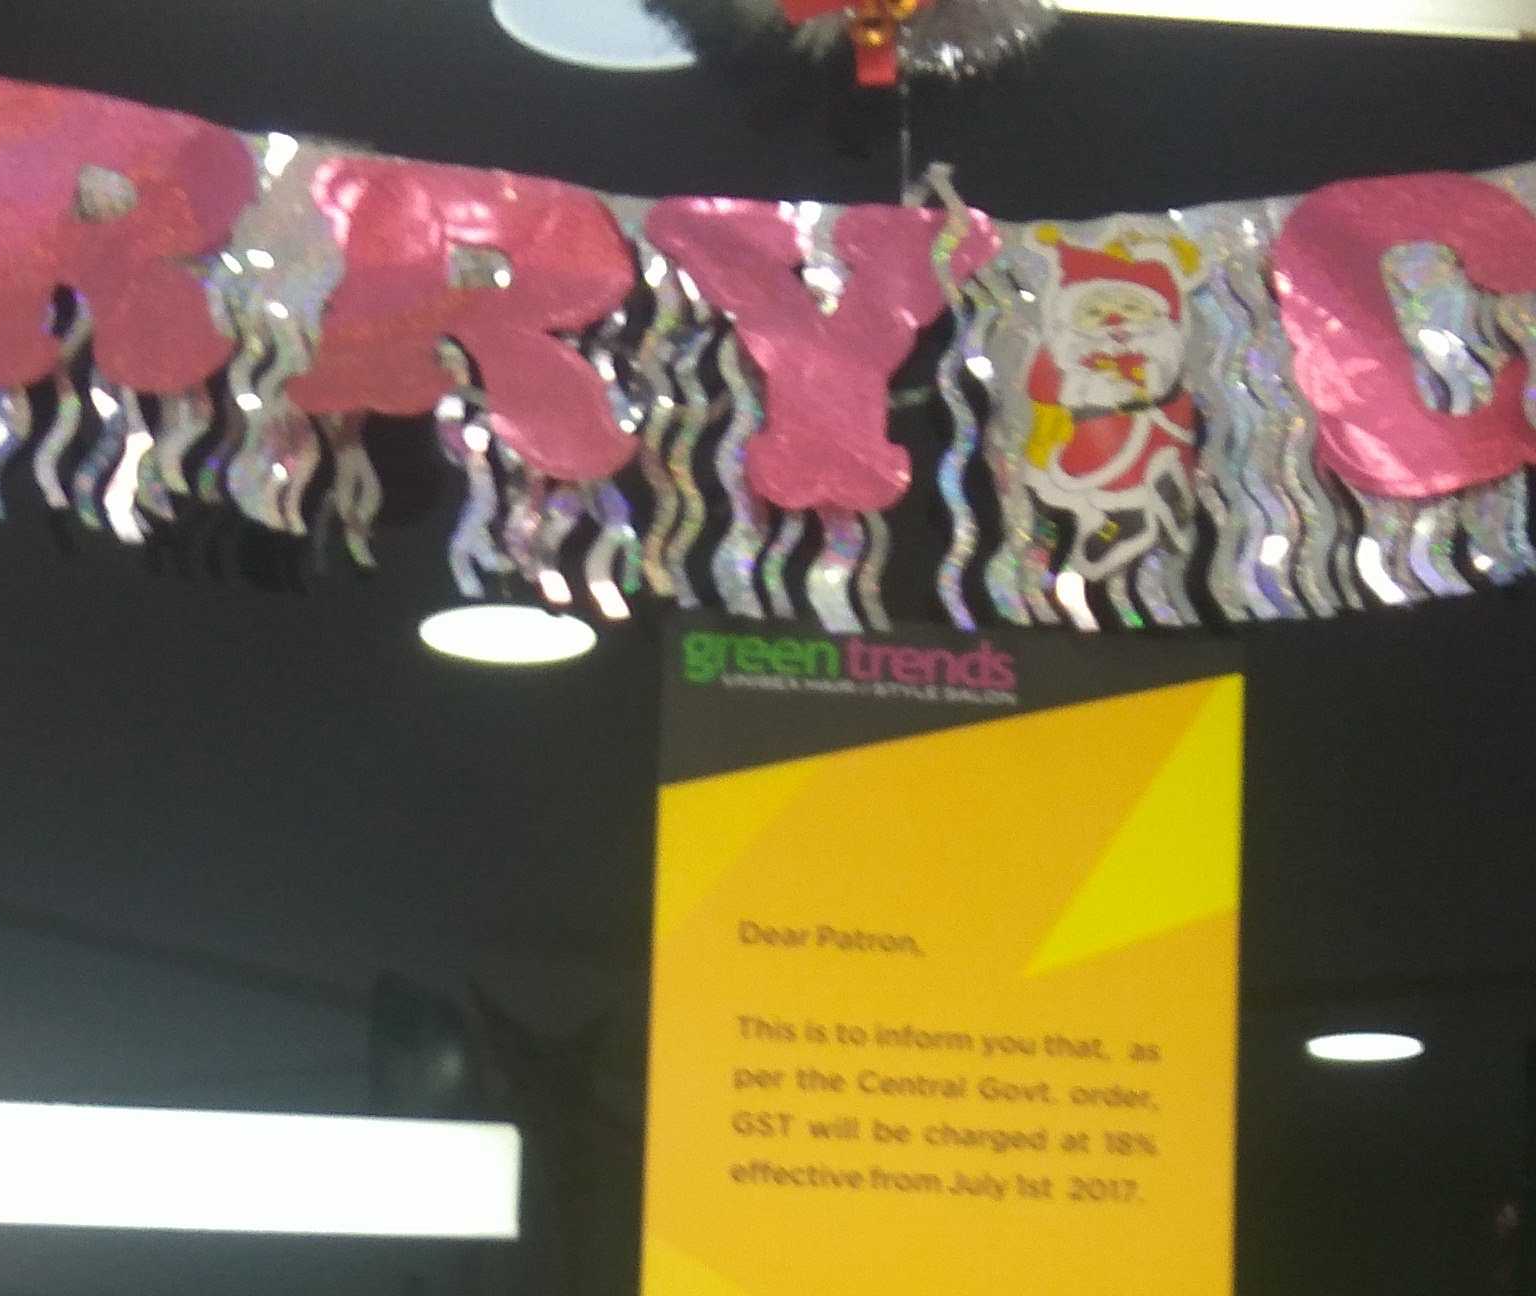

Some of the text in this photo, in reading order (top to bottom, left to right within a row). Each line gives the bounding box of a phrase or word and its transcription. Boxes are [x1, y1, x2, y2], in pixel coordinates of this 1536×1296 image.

[683, 631, 1017, 690] green trends
[738, 920, 808, 948] Dear
[736, 1015, 797, 1043] This
[803, 1018, 827, 1045] is
[836, 1023, 866, 1047] to
[874, 1022, 973, 1052] inform
[980, 1036, 1036, 1057] you
[1128, 1039, 1162, 1062] as
[732, 1066, 785, 1092] per
[796, 1065, 846, 1093] the
[858, 1069, 966, 1099] Central
[731, 1110, 1159, 1157] GST will be charged at 18%
[730, 1158, 863, 1190] effective
[869, 1164, 941, 1192] from
[947, 1171, 1007, 1201] July
